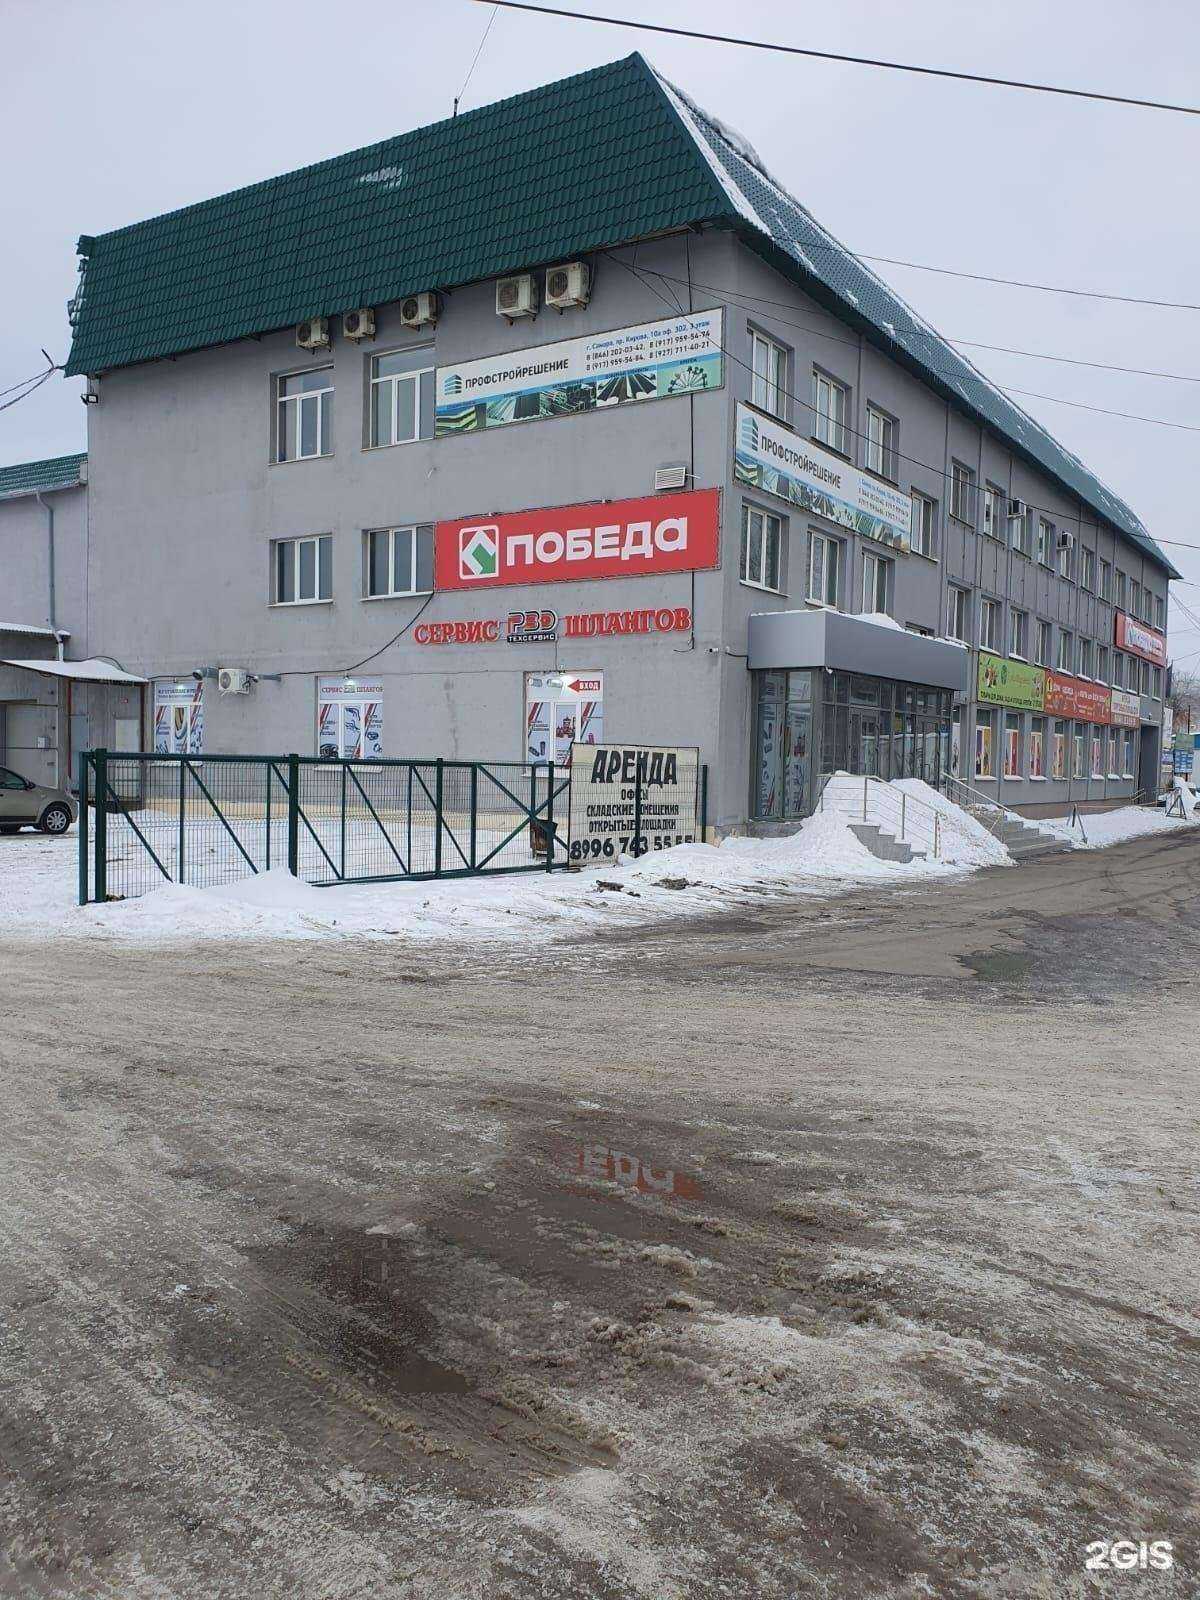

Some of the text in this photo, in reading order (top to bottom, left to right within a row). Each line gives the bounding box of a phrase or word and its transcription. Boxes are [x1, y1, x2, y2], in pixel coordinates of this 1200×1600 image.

[465, 358, 569, 388] ПРОФСТРОЙРЕШЕНИЕ
[761, 435, 841, 490] ПРОФСТРОЙРЕШЕНИЕ
[414, 619, 500, 645] СЕРВИС
[564, 607, 692, 638] ШЛАНГОВ
[508, 633, 556, 643] ТЕХСЕРВИС
[579, 681, 599, 690] ВХОД
[591, 749, 677, 788] АРЕНДА
[621, 788, 649, 800] ОФСЫ
[586, 804, 679, 817] СКЛАДСКИЕ ОМЕЩЕНИЯ
[589, 818, 677, 833] ОТКРЫТЫЕ ЛОЩАДКИ
[569, 837, 614, 860] 8996
